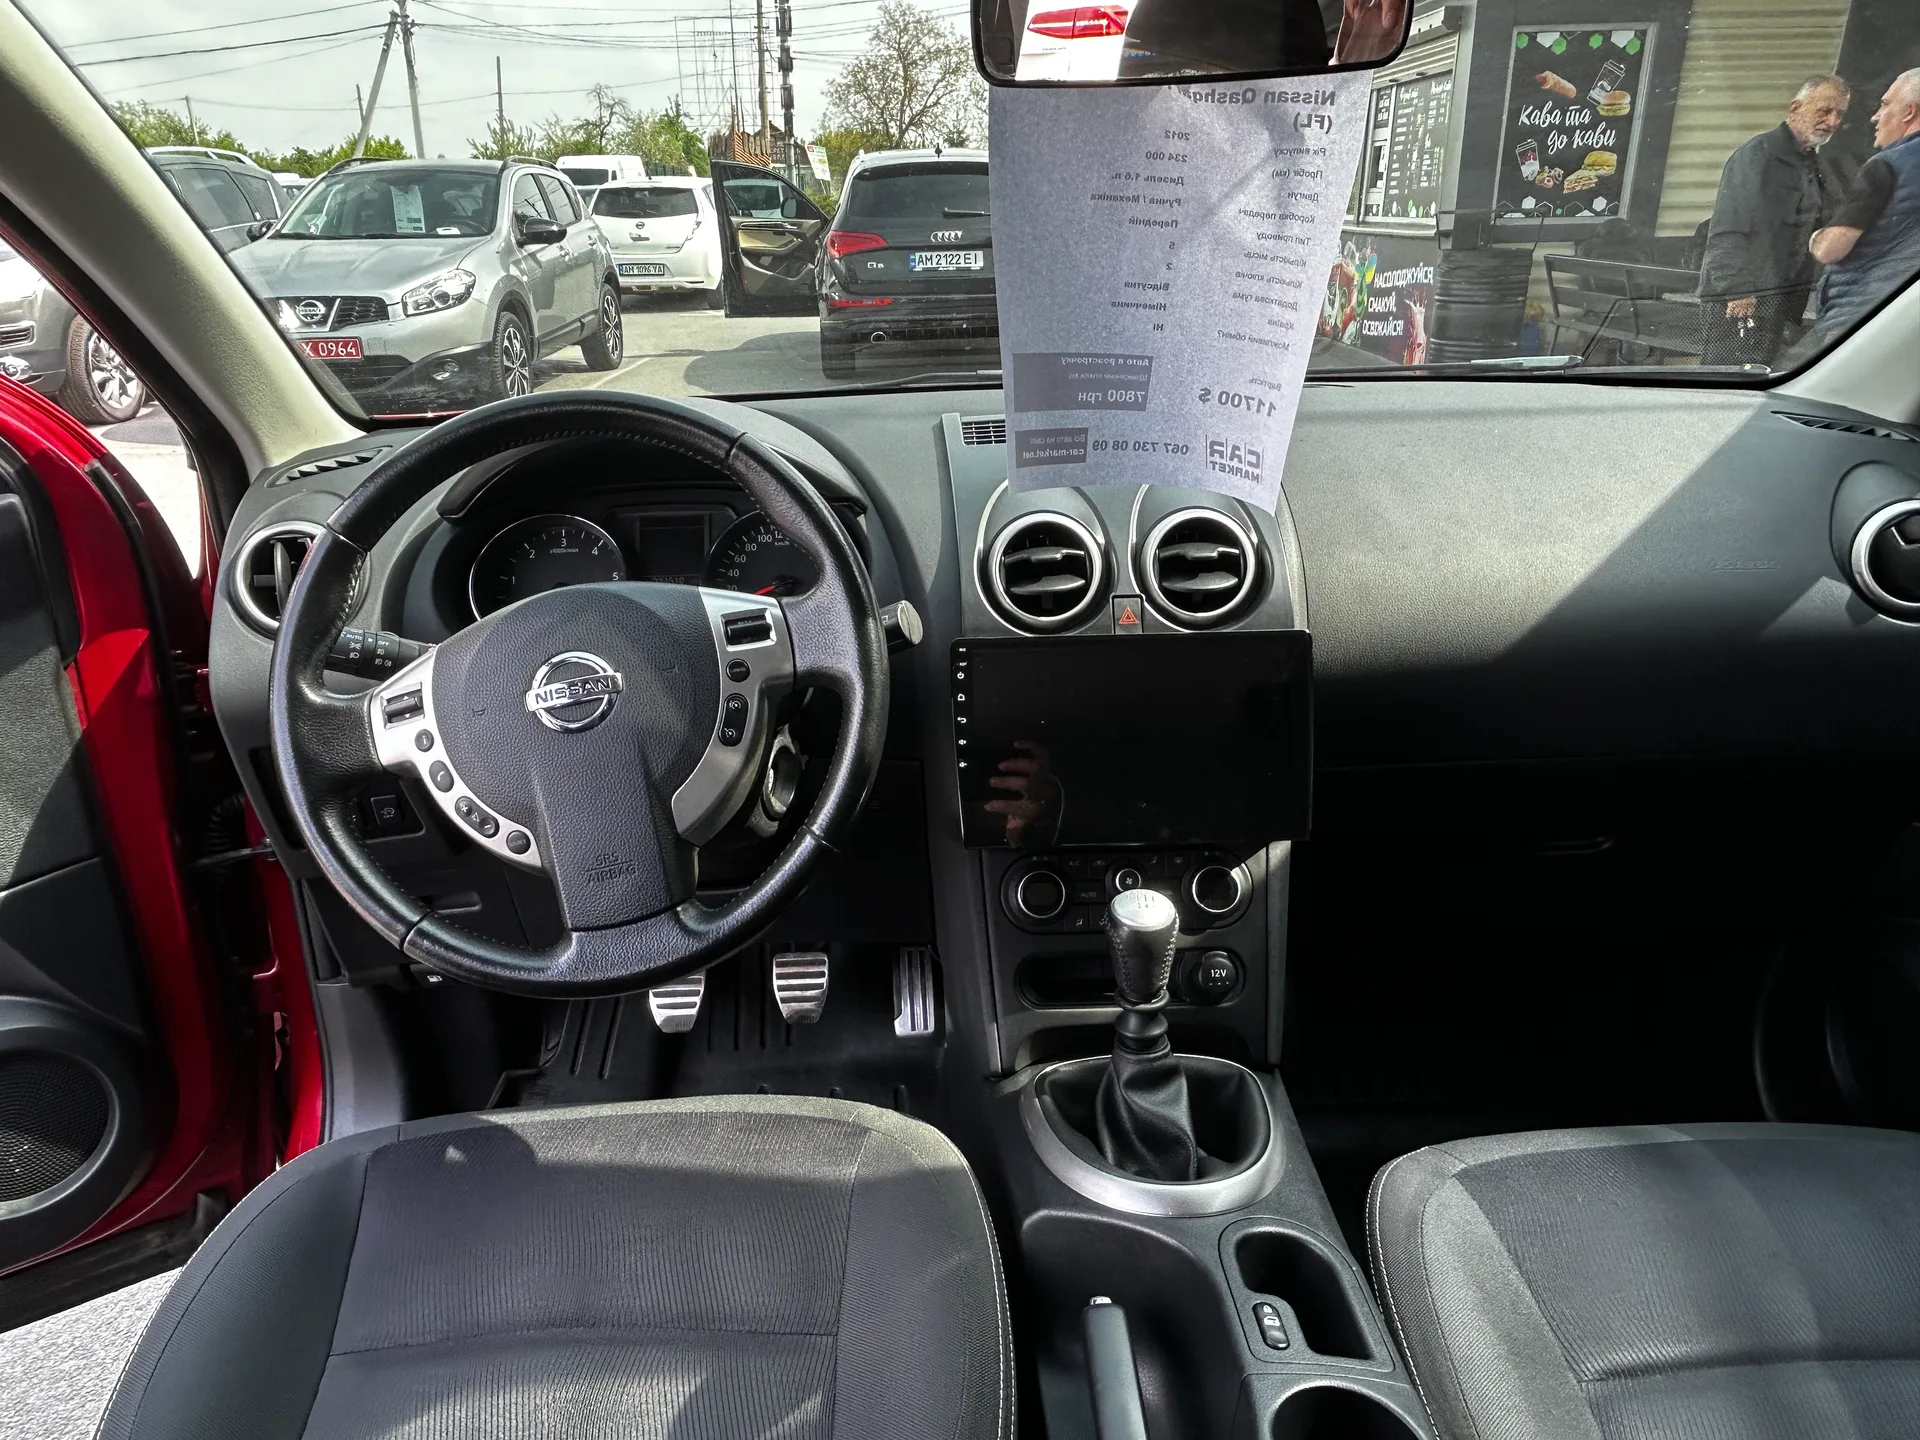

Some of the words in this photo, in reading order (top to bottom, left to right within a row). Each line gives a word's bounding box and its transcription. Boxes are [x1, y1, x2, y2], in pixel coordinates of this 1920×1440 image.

[1518, 100, 1563, 128] Кава
[1565, 105, 1592, 126] та
[1547, 130, 1568, 155] до
[1572, 121, 1617, 149] кави
[917, 254, 933, 267] AM
[935, 253, 962, 266] 2122
[318, 341, 357, 357] 0964
[560, 537, 567, 547] 3
[757, 534, 773, 543] 100
[591, 546, 599, 556] 4
[744, 543, 757, 552] 80
[529, 549, 536, 559] 2
[734, 554, 747, 563] 60
[612, 572, 619, 581] 5
[727, 568, 740, 577] 40
[534, 677, 612, 705] NISSAN
[1210, 968, 1227, 978] 12V
